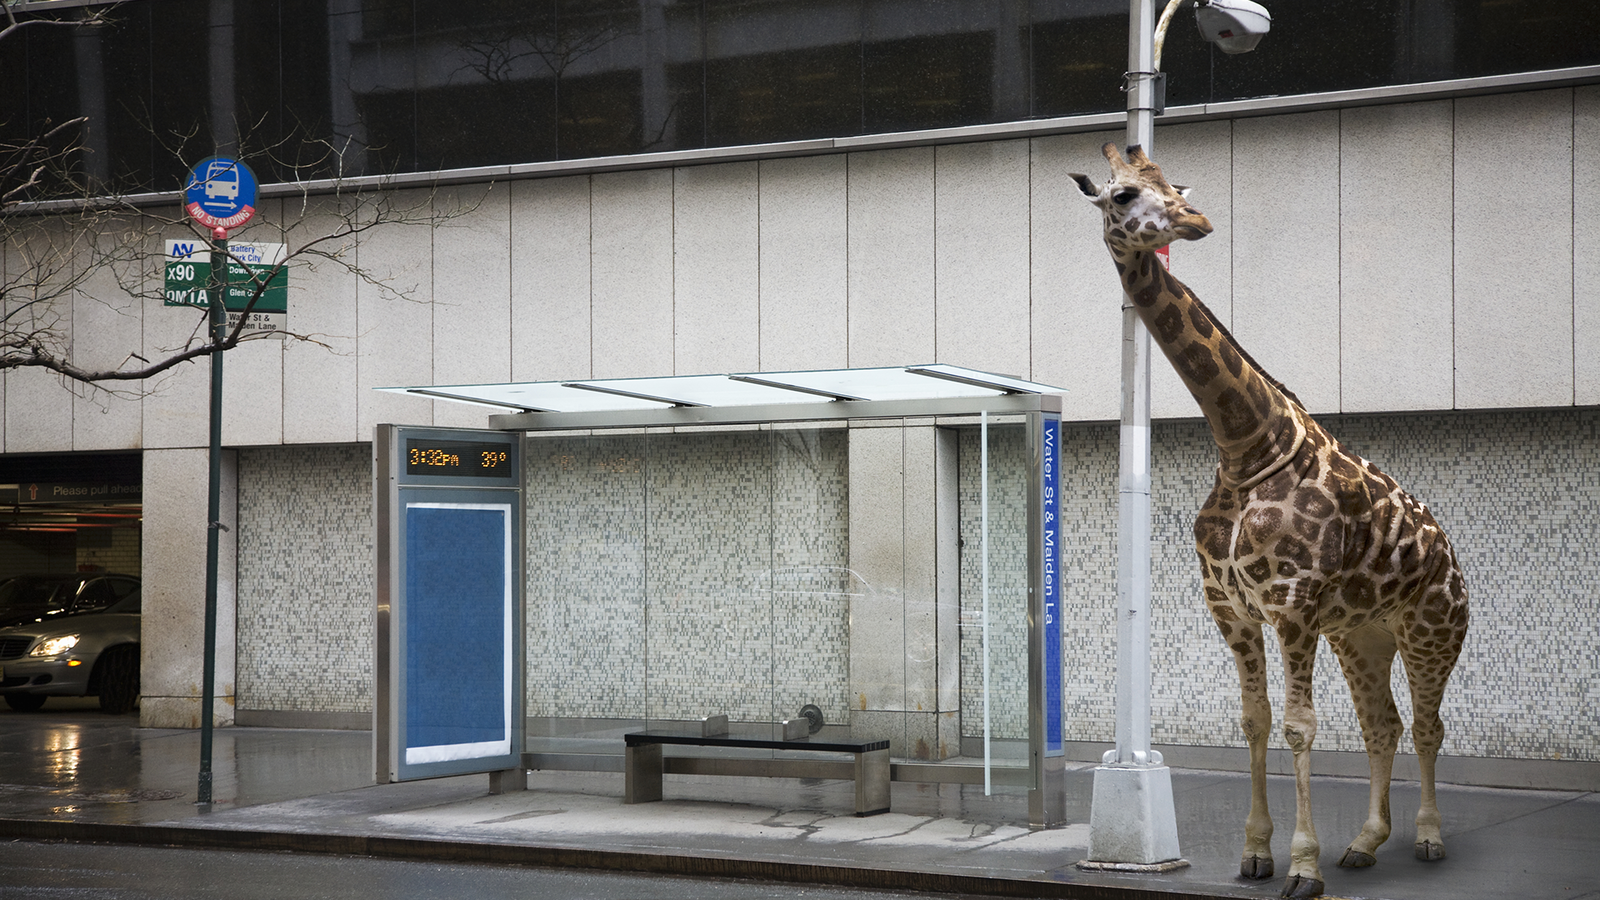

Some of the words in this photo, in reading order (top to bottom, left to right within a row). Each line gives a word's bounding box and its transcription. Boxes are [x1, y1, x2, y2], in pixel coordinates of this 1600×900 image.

[192, 206, 205, 218] NO
[206, 210, 250, 226] STANDING
[230, 245, 255, 254] Battery
[247, 254, 261, 263] City
[229, 266, 265, 275] Downown
[229, 288, 245, 297] Glen
[247, 288, 265, 297] Os
[229, 313, 251, 321] War
[253, 314, 262, 322] St
[264, 314, 270, 322] &
[229, 322, 256, 330] Men
[258, 322, 277, 331] Lane
[1044, 428, 1054, 481] Water
[53, 486, 88, 496] Please
[90, 484, 108, 496] pull
[111, 484, 142, 494] ahead
[1044, 486, 1054, 506] St
[1044, 511, 1054, 524] &
[1045, 530, 1054, 596] Maiden
[1045, 603, 1054, 625] La
